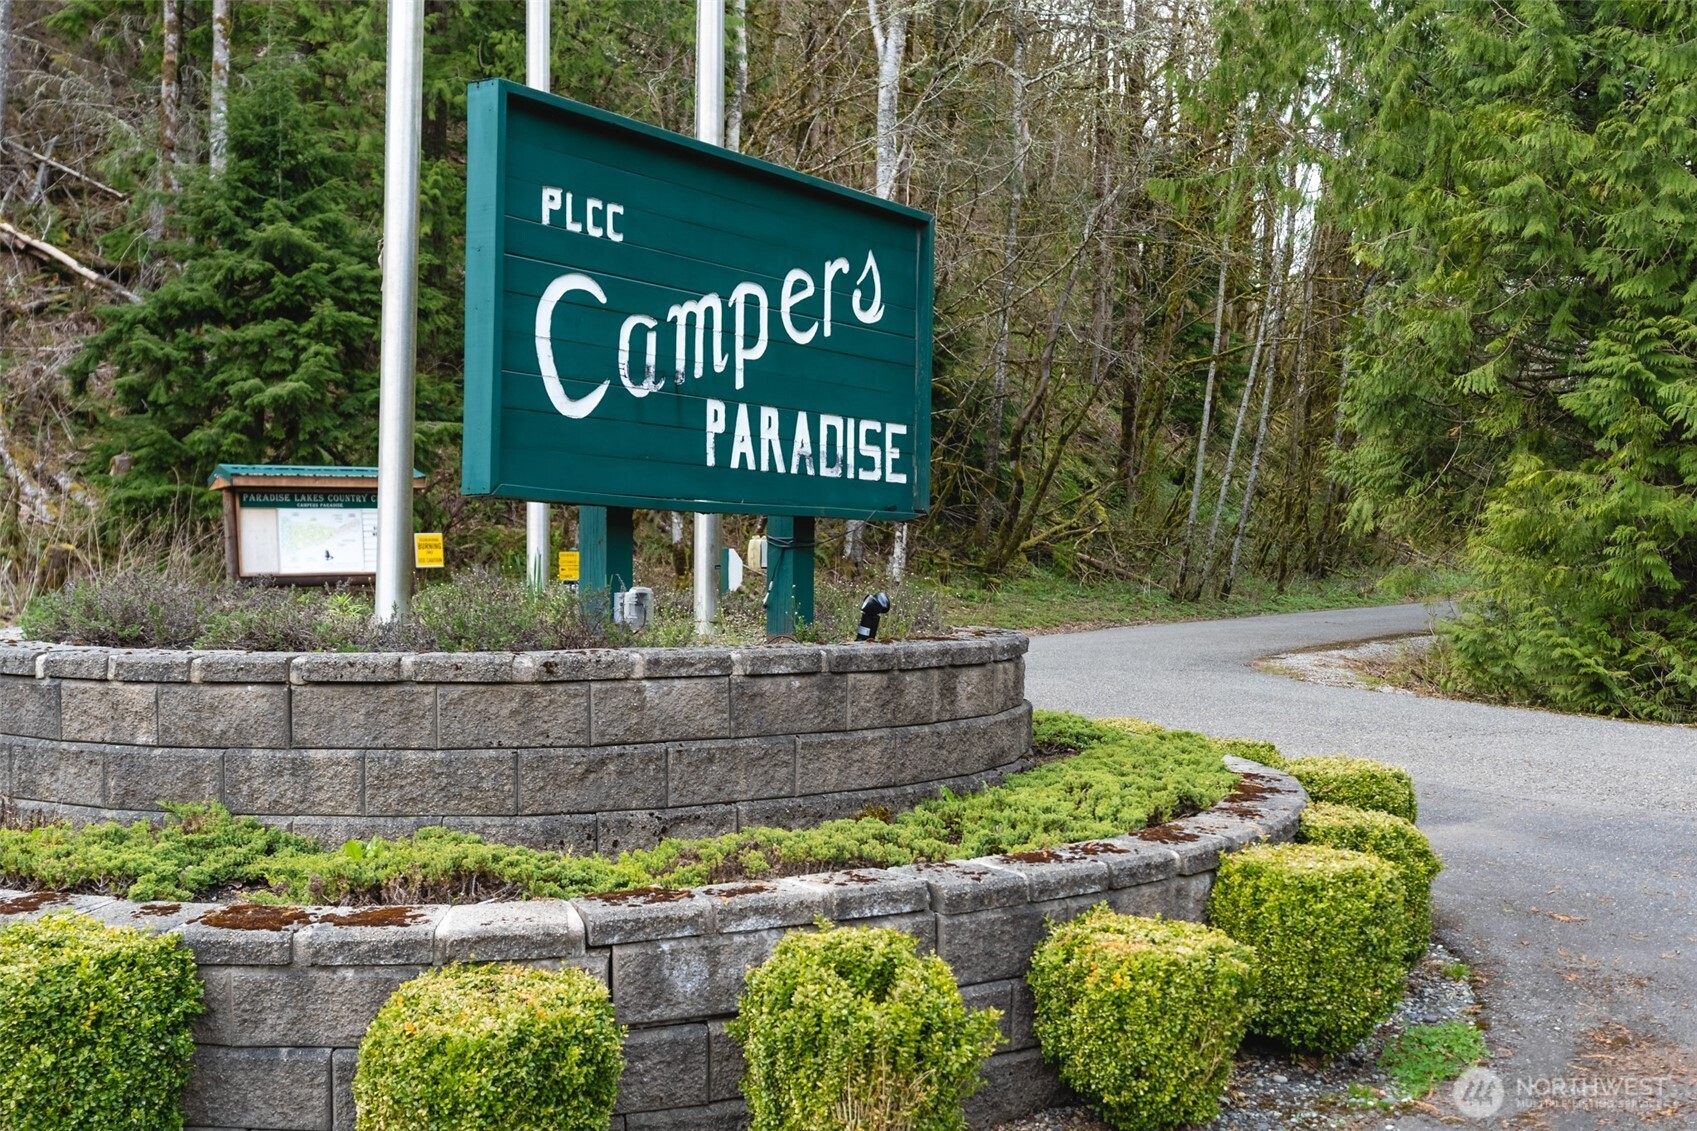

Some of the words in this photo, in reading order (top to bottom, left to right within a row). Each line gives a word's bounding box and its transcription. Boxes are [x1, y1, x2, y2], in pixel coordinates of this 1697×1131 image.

[541, 185, 624, 242] PLCC
[535, 249, 885, 419] Campers
[706, 398, 907, 484] PARADISE
[242, 493, 290, 502] PARADISE
[294, 493, 324, 502] LAKES
[328, 493, 368, 502] COUNTRY
[417, 542, 442, 550] BURNING
